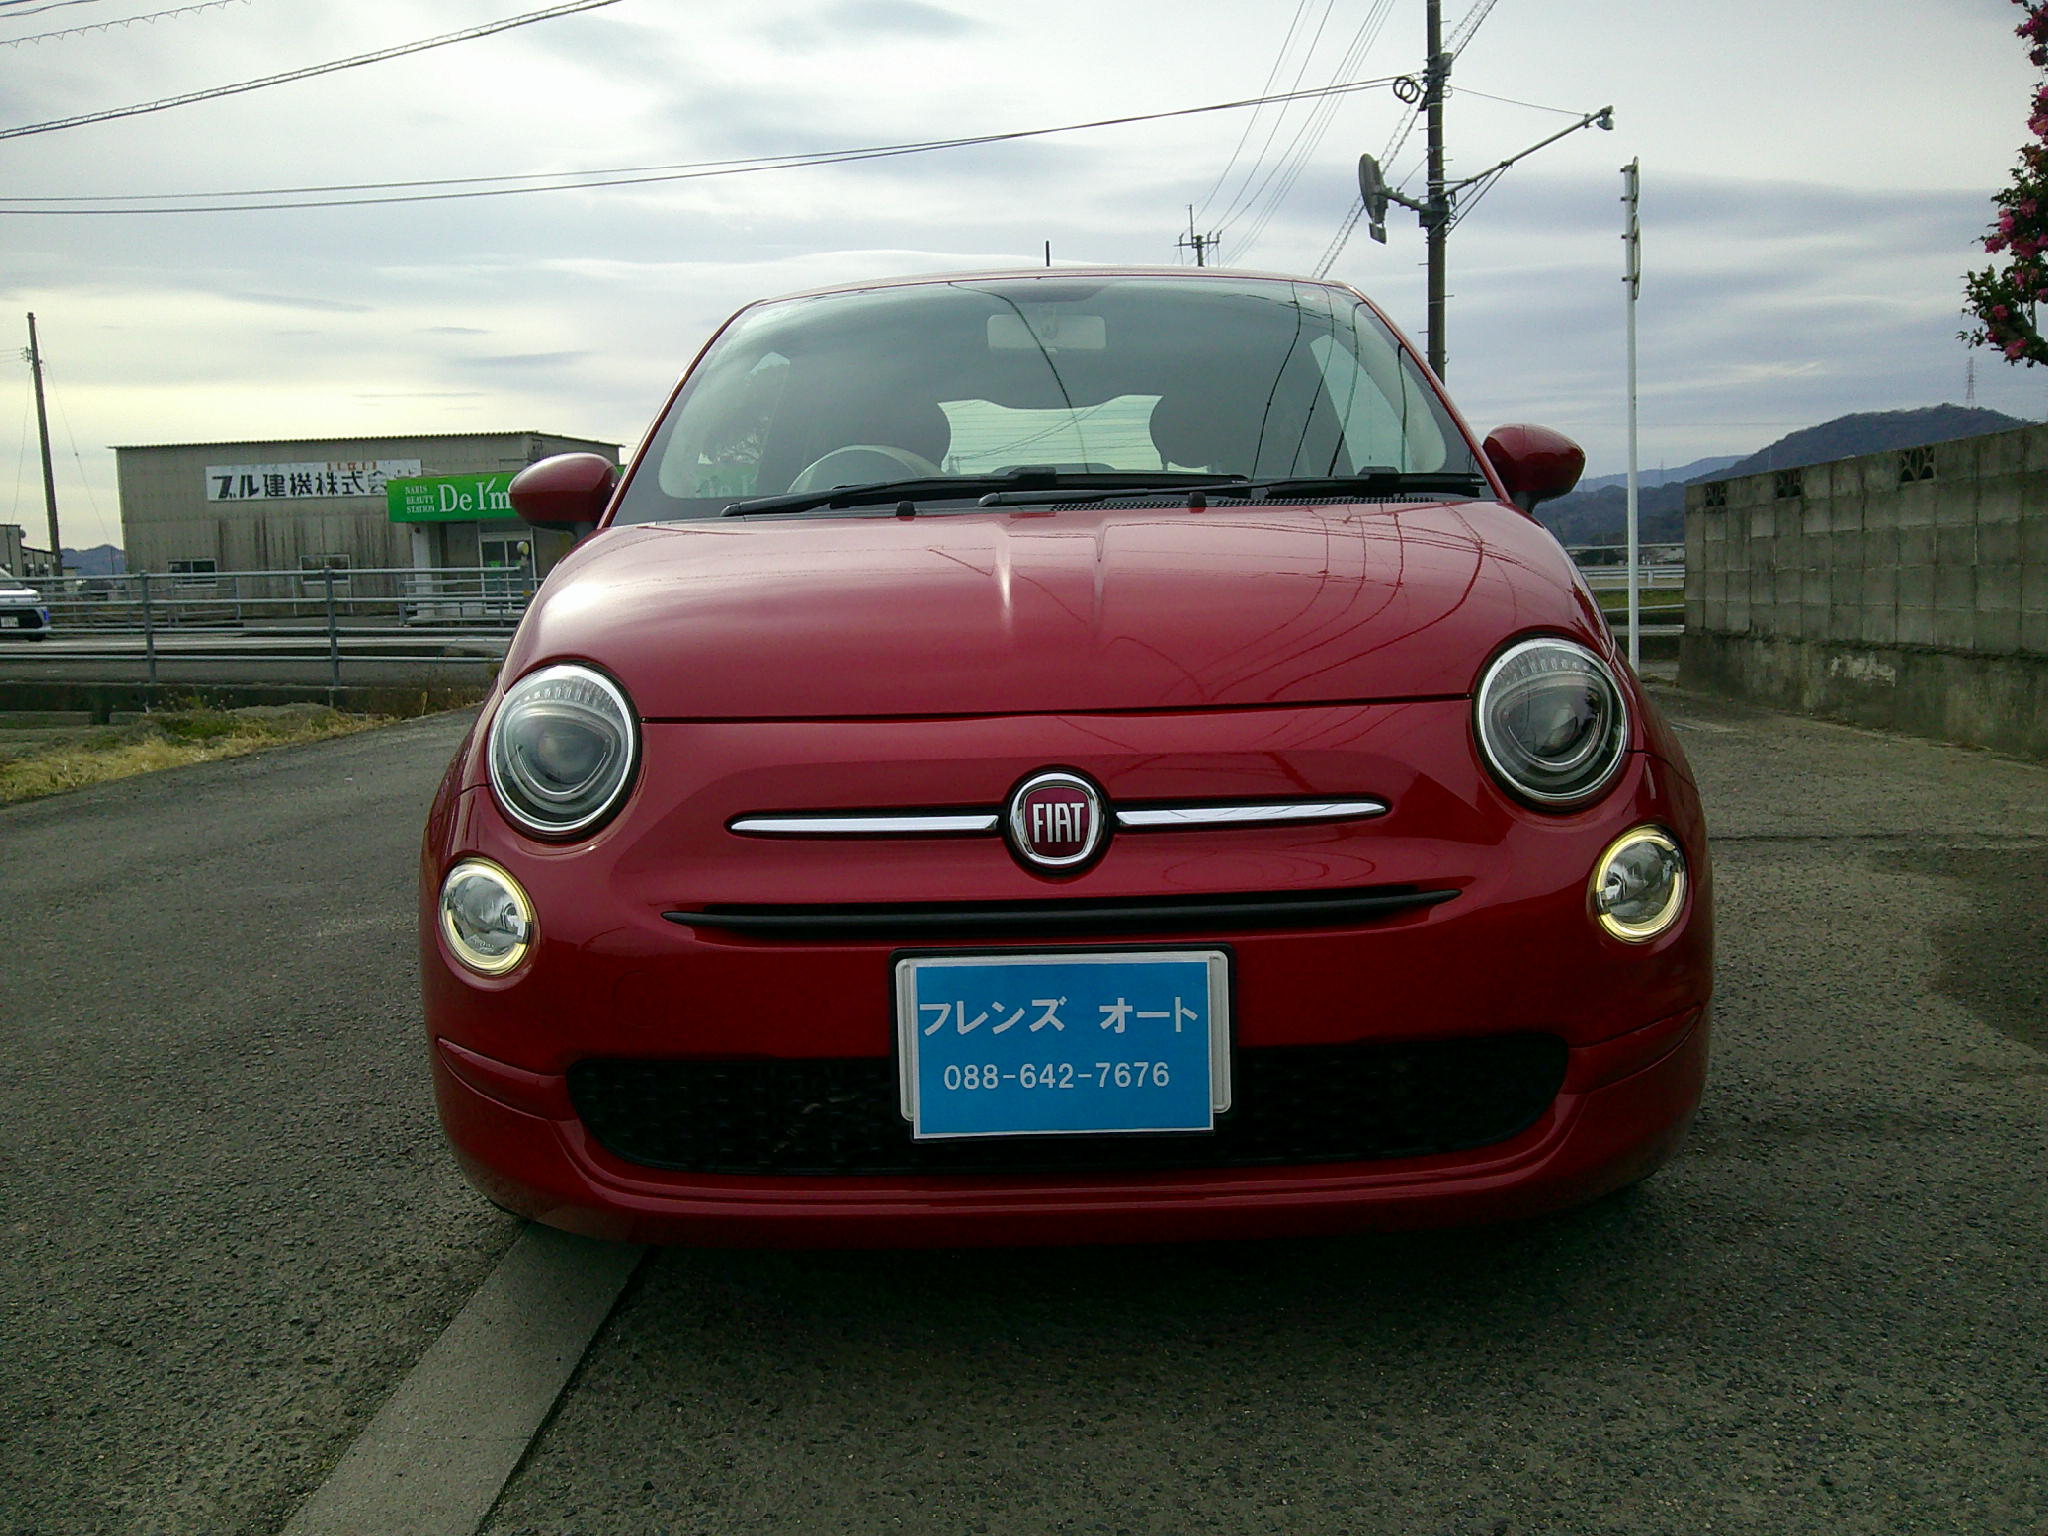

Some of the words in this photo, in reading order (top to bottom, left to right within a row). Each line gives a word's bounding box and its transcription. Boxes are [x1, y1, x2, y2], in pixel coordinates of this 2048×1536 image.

[406, 503, 435, 513] STATION
[437, 484, 473, 512] De
[1032, 803, 1085, 843] FIAT
[919, 996, 1068, 1036] フレンズ
[1098, 997, 1198, 1034] オート
[943, 1062, 1170, 1090] 088-642-7676
